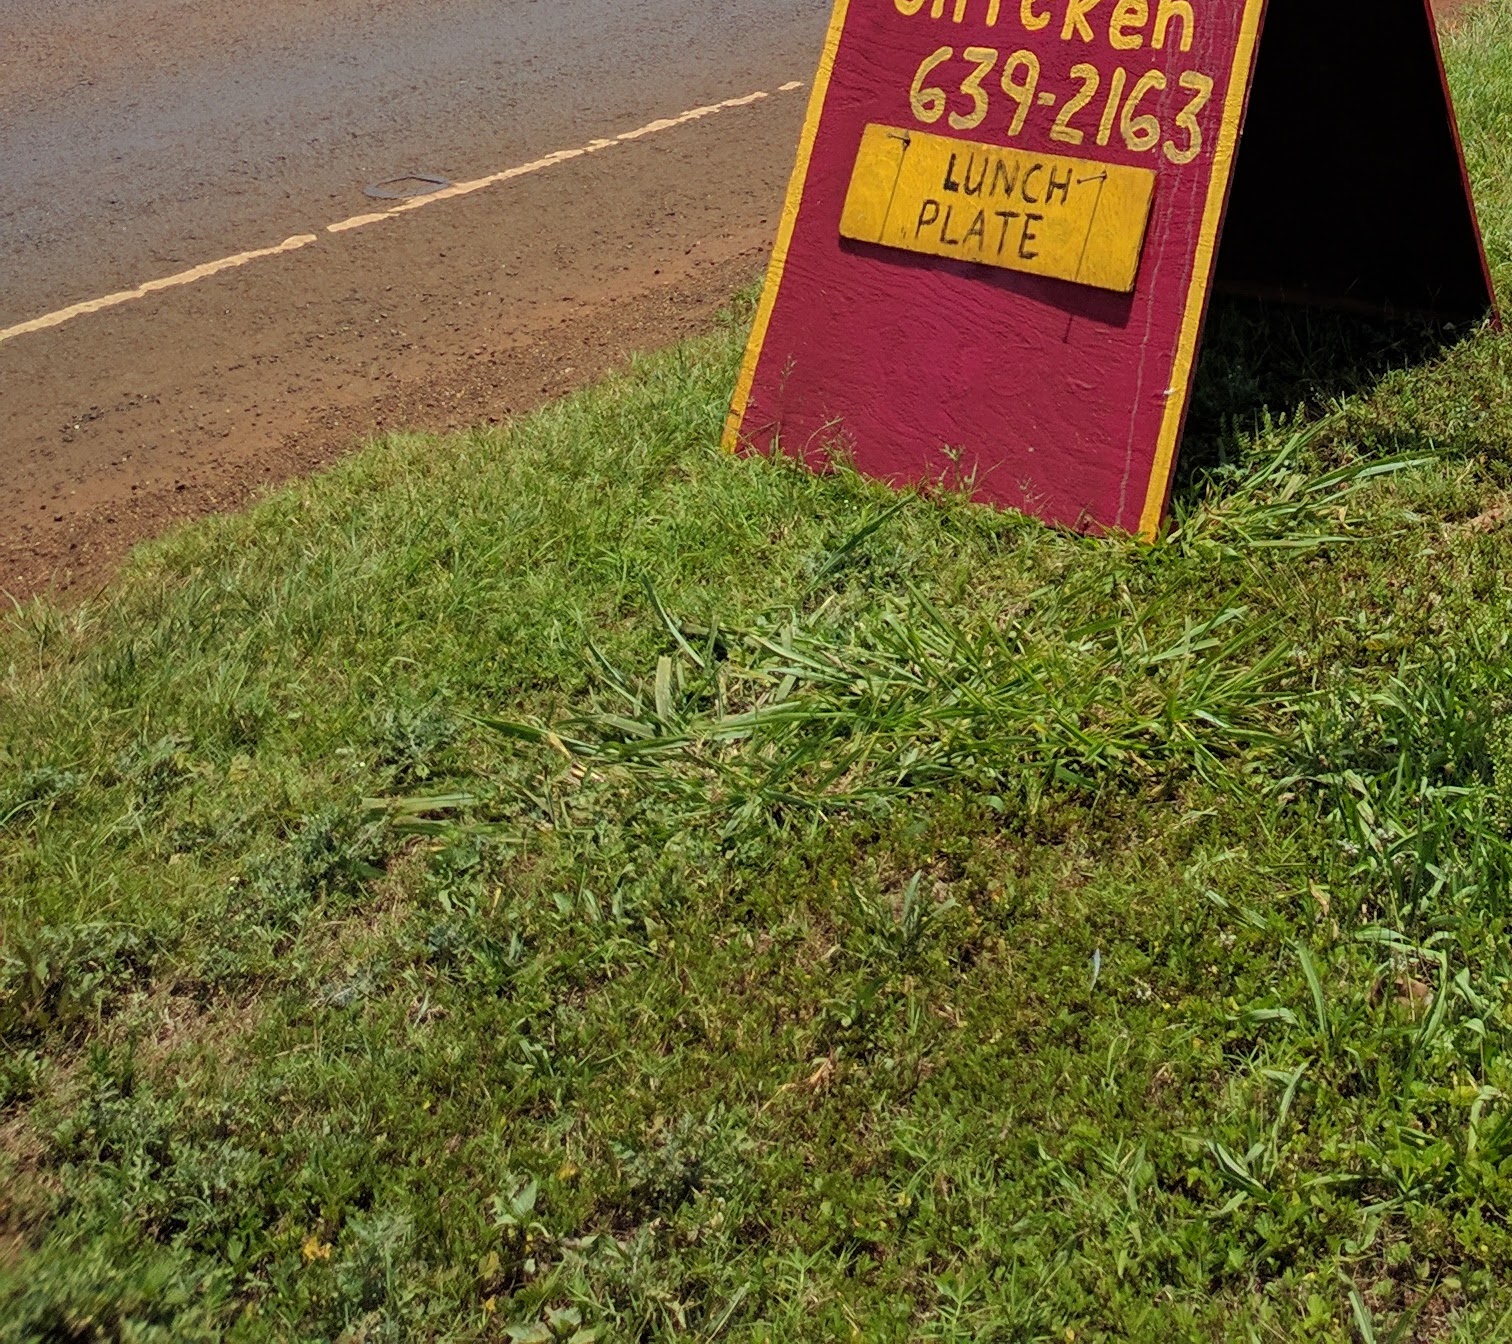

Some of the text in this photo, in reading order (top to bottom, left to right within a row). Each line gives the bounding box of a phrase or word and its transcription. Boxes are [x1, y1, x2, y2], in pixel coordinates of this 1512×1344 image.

[909, 45, 1214, 164] 639-2163
[942, 153, 1072, 205] LUNCH
[916, 200, 1044, 260] PLATE
